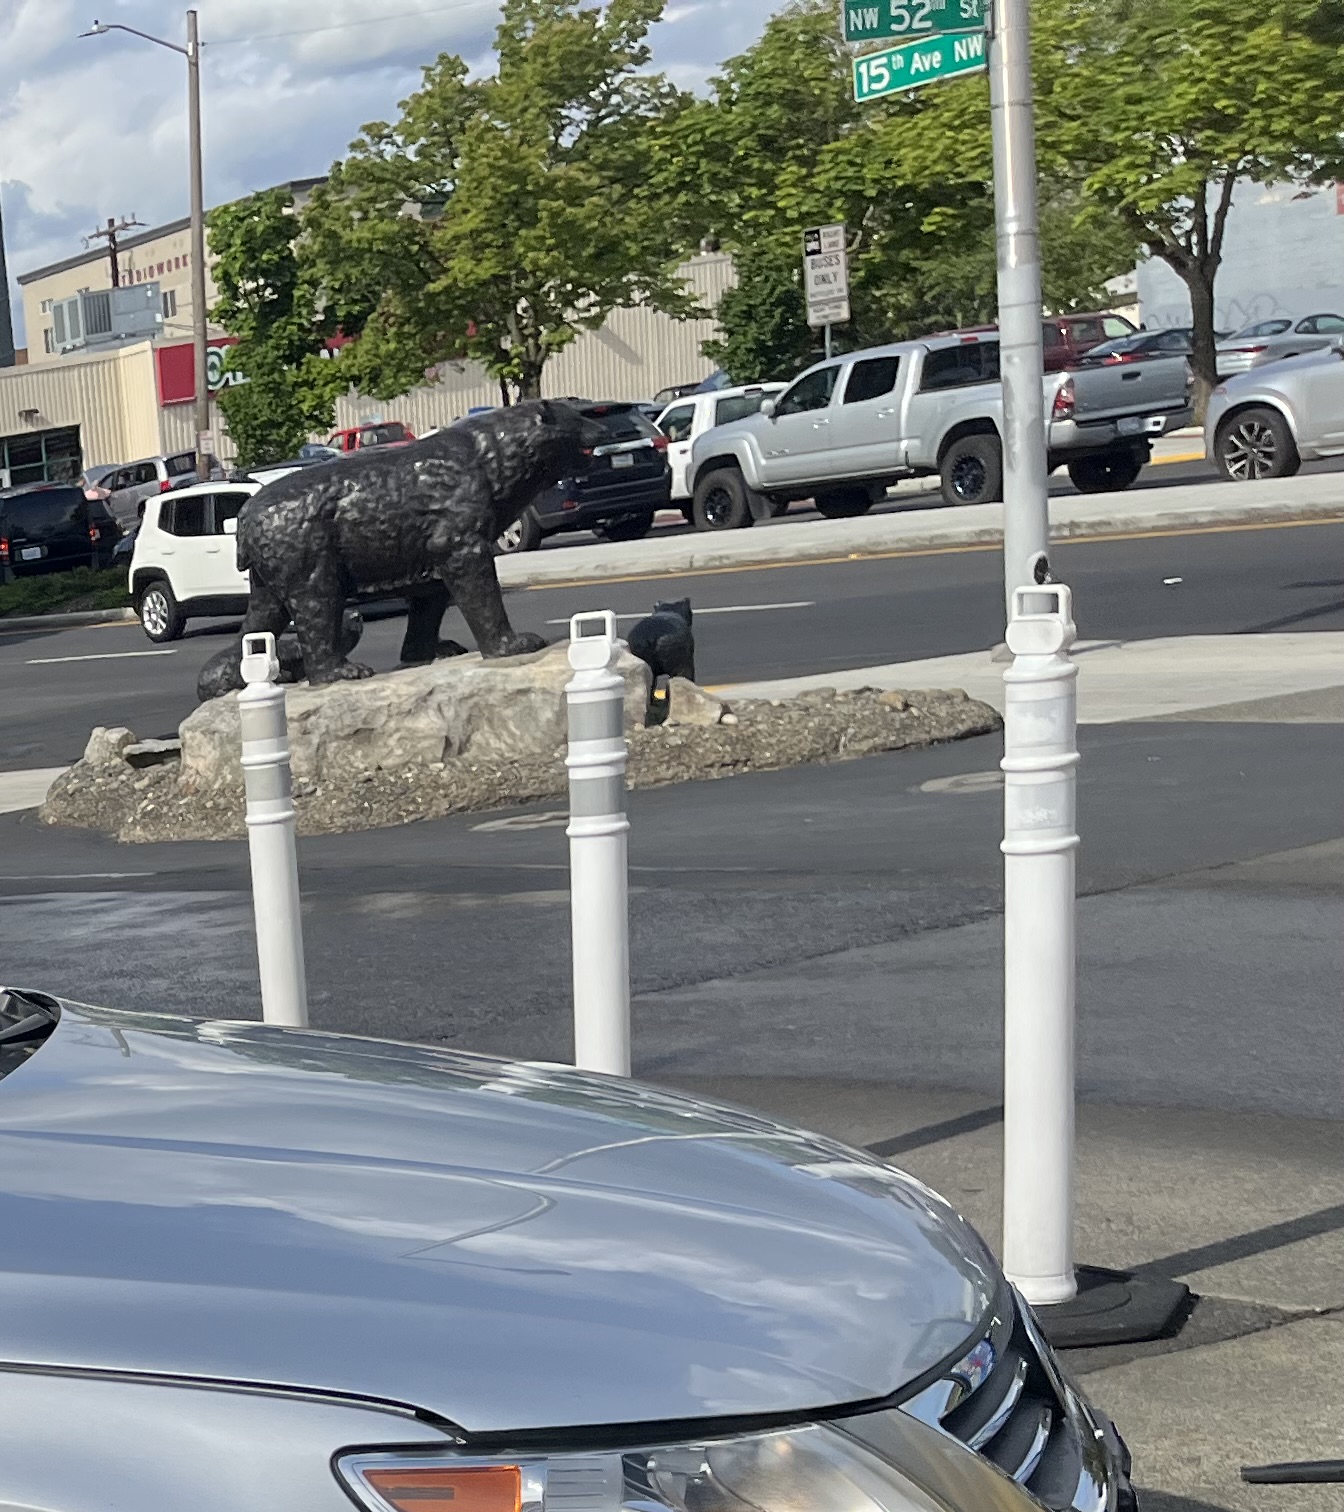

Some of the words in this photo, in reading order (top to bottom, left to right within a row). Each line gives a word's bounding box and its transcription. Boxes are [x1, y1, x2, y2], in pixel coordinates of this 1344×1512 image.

[849, 7, 879, 31] NW
[858, 54, 905, 94] 15th
[909, 51, 942, 75] Ave
[953, 34, 983, 62] NW
